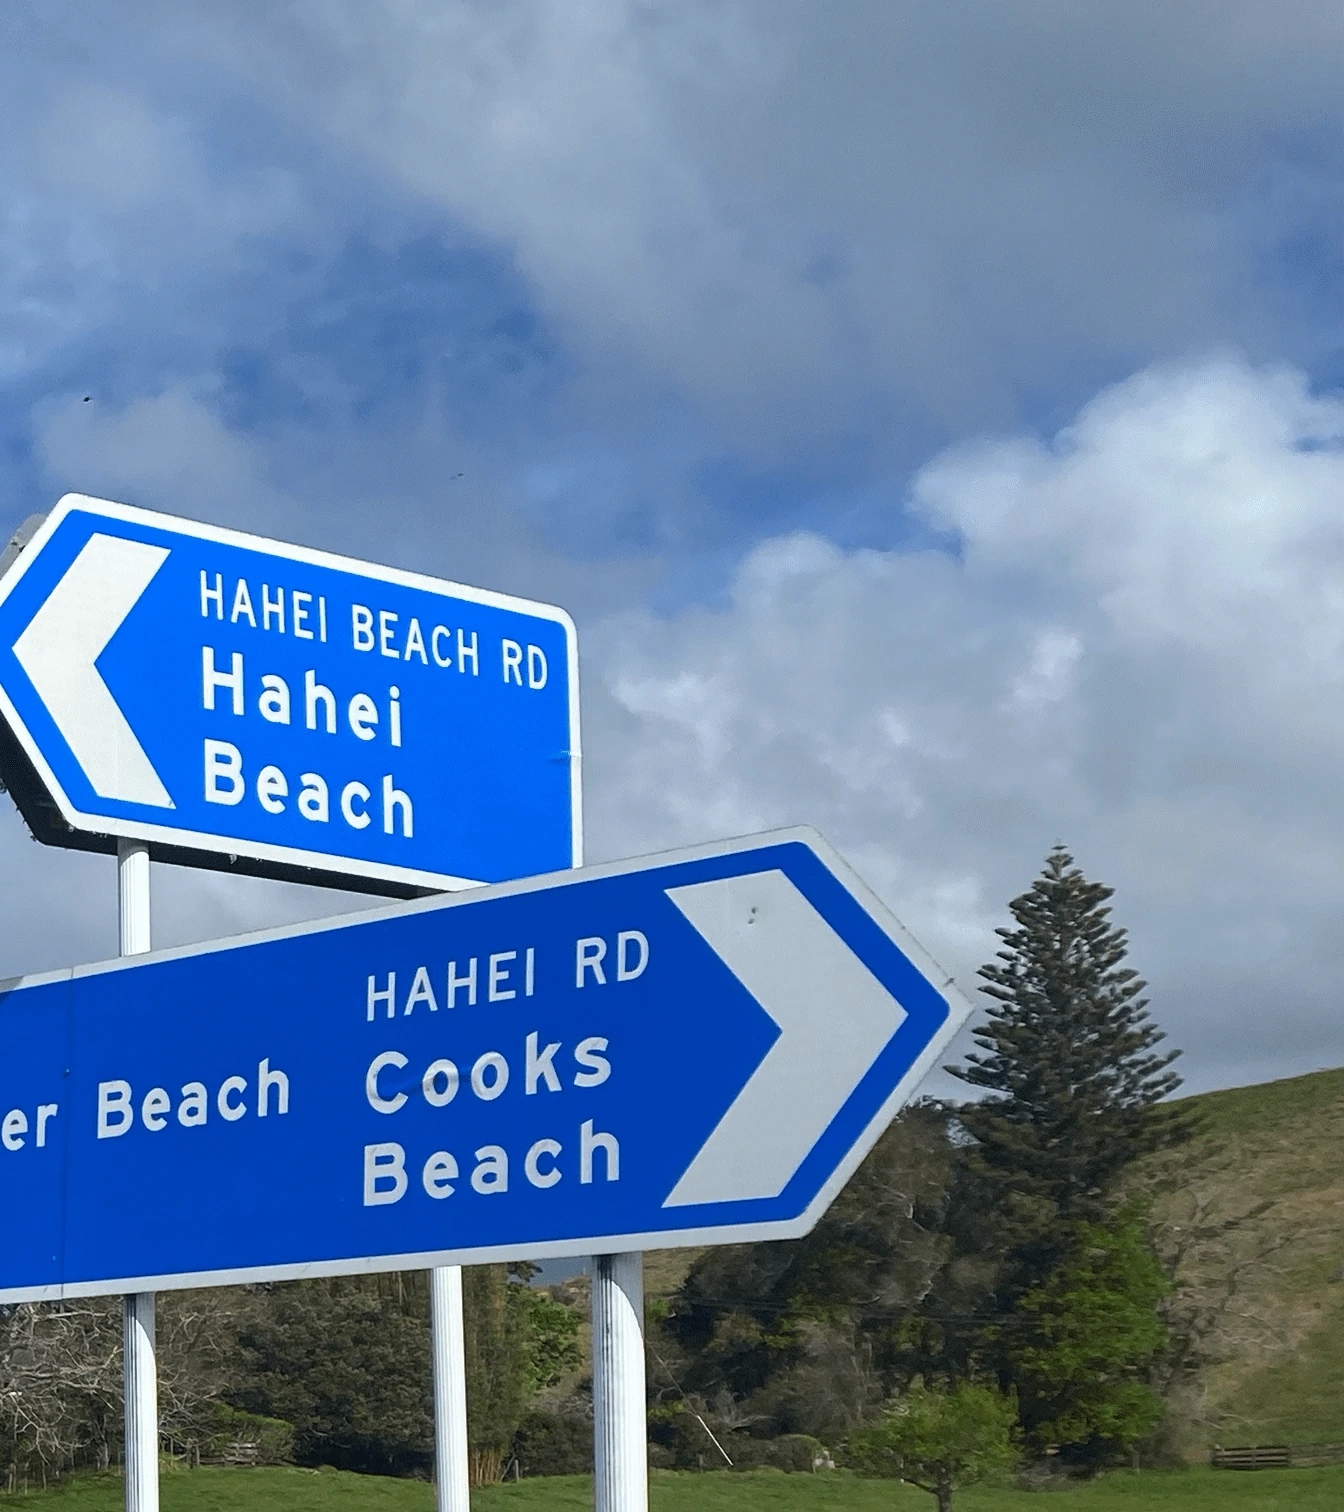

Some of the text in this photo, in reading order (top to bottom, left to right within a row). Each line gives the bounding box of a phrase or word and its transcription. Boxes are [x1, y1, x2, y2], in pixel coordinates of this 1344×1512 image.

[200, 570, 548, 690] HAHEI BEACH RD
[202, 647, 402, 747] Hahei
[204, 739, 413, 838] Beach
[367, 930, 649, 1022] HAHEI RD
[97, 1057, 289, 1139] Beach
[365, 1031, 611, 1114] Cooks
[363, 1119, 620, 1207] Beach
